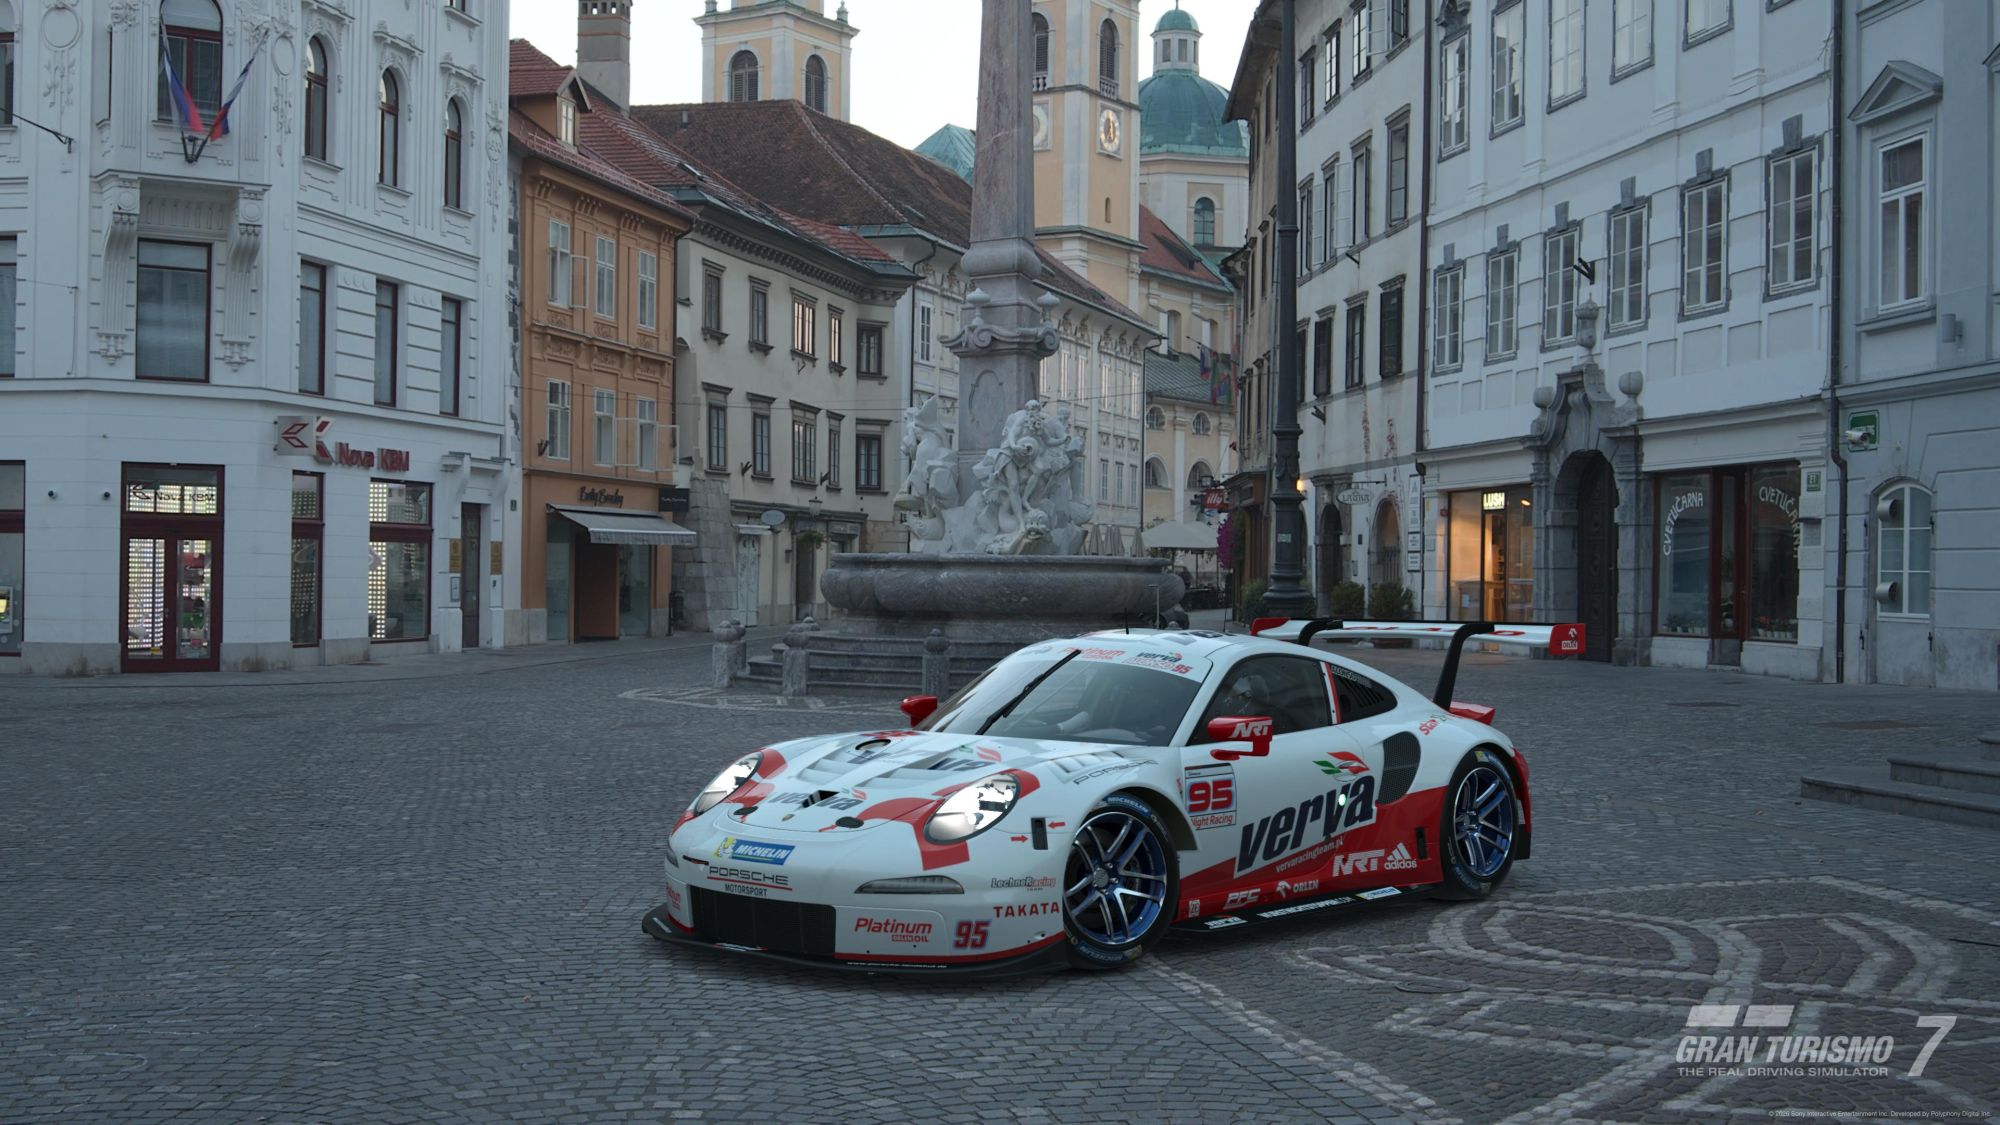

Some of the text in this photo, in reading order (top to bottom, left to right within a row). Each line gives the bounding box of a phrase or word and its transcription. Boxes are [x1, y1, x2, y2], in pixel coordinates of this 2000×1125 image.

[335, 441, 410, 471] Nova KBM
[156, 491, 183, 501] Nova
[1206, 493, 1223, 506] illy
[1483, 492, 1505, 507] LUSH
[1136, 652, 1182, 663] verva
[1171, 663, 1193, 674] 95
[1229, 719, 1273, 739] NRT
[1188, 779, 1233, 813] 95
[1106, 796, 1149, 814] MICHELIN
[1209, 814, 1233, 826] Racing
[1237, 776, 1375, 872] verva
[736, 844, 791, 860] MICHELIN
[1275, 837, 1344, 873] vervaracingteam.pl
[1332, 849, 1385, 877] NRT
[1384, 859, 1417, 871] adidas
[709, 866, 789, 885] PORSCHE
[725, 884, 767, 897] MOTORSPORT
[1293, 879, 1319, 893] ORLEN
[993, 901, 1060, 918] TAKATA
[854, 918, 932, 935] Platinum
[954, 920, 991, 949] 95
[914, 935, 928, 943] OIL
